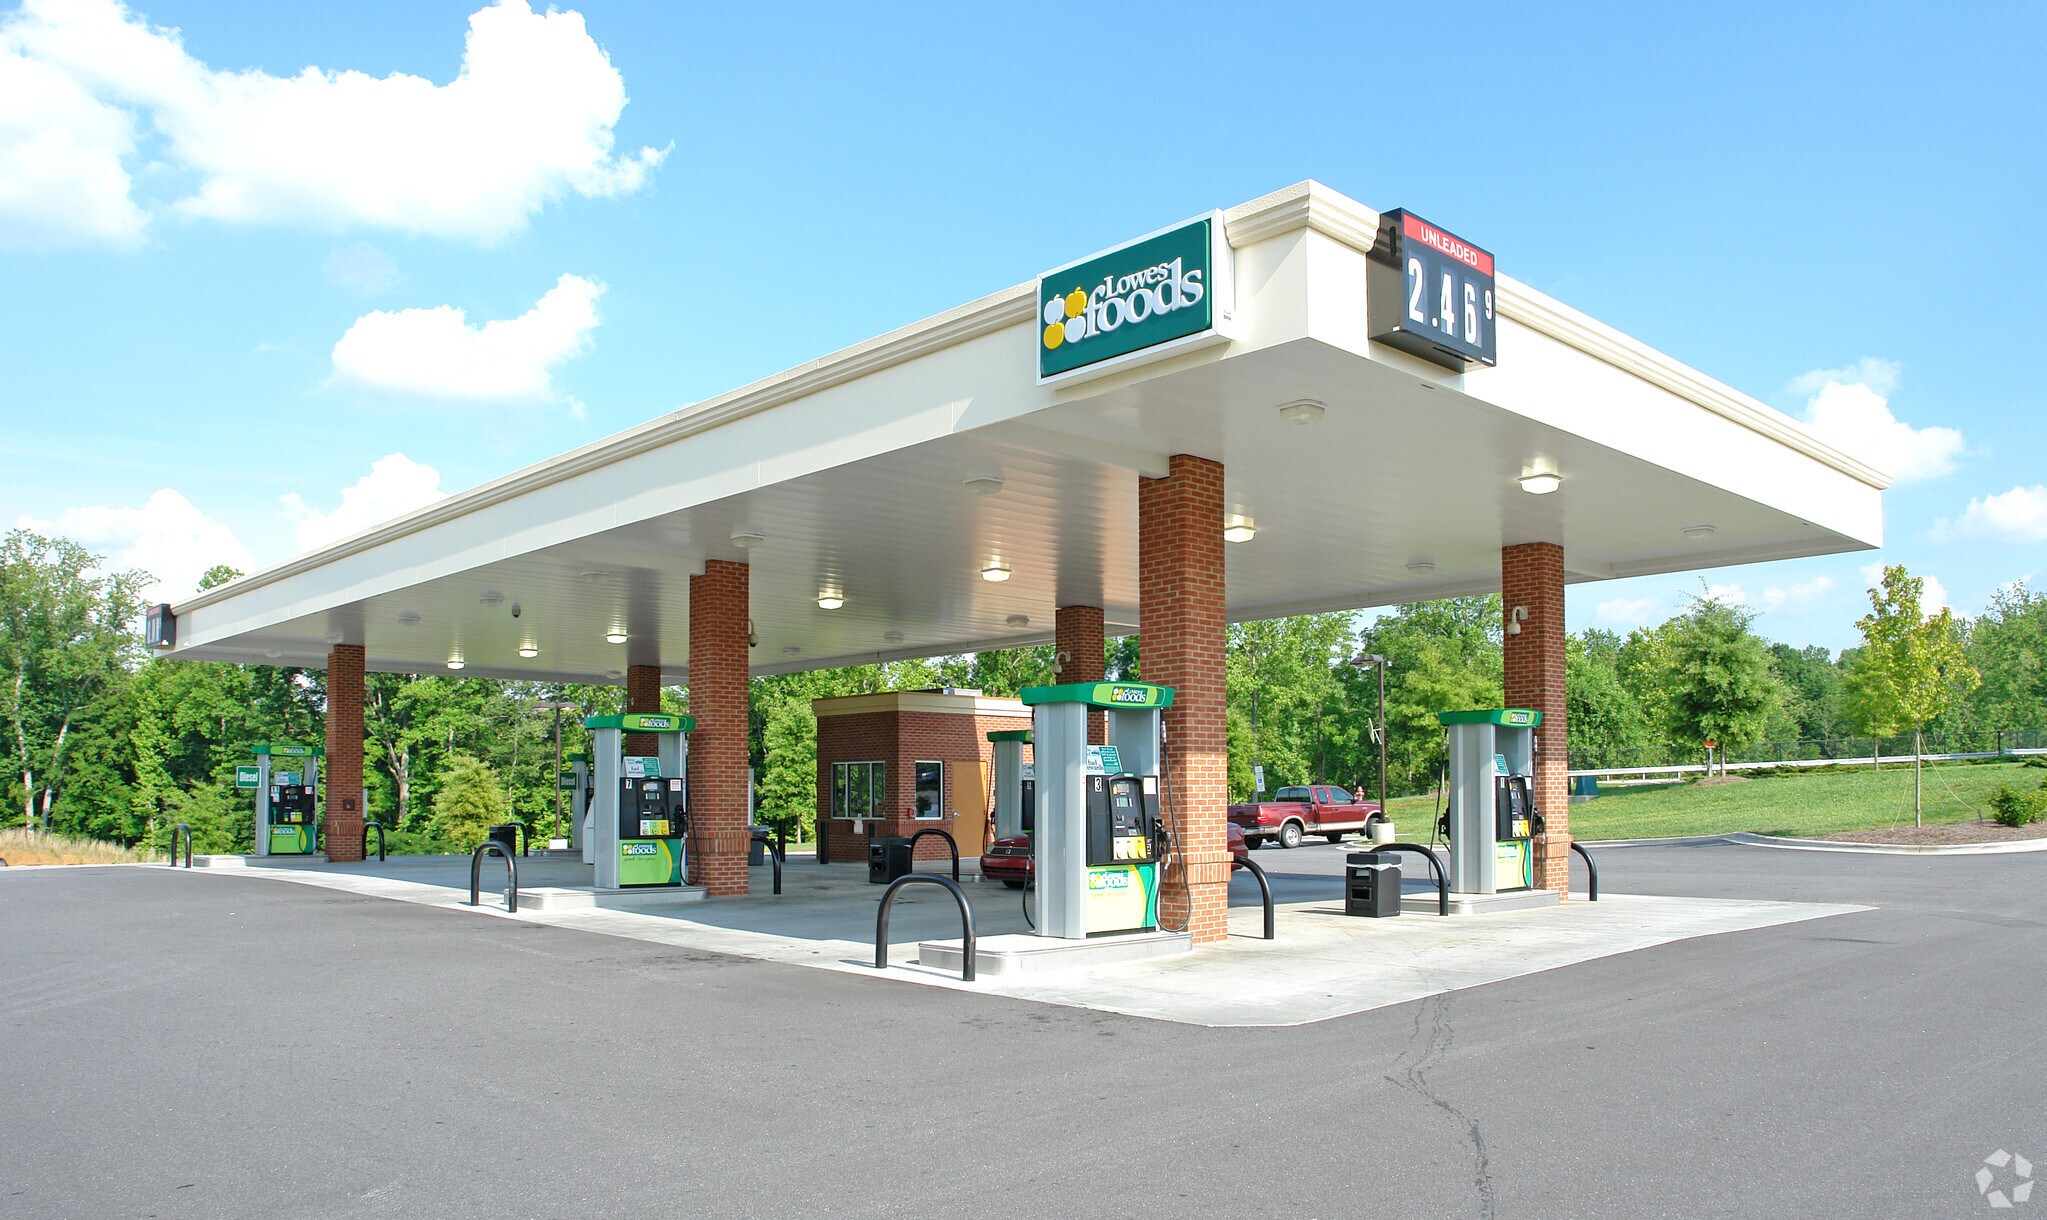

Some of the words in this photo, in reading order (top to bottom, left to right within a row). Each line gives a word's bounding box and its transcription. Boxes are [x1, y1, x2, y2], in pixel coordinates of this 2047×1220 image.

[1420, 225, 1478, 266] UNLEADED
[1104, 262, 1168, 299] Lowes
[1083, 256, 1204, 339] foods
[1484, 289, 1492, 320] 9
[1121, 688, 1146, 702] foods
[648, 718, 670, 728] foods
[240, 772, 258, 782] Diesel
[627, 779, 631, 789] 7
[1096, 778, 1101, 791] 3
[632, 843, 657, 854] foods
